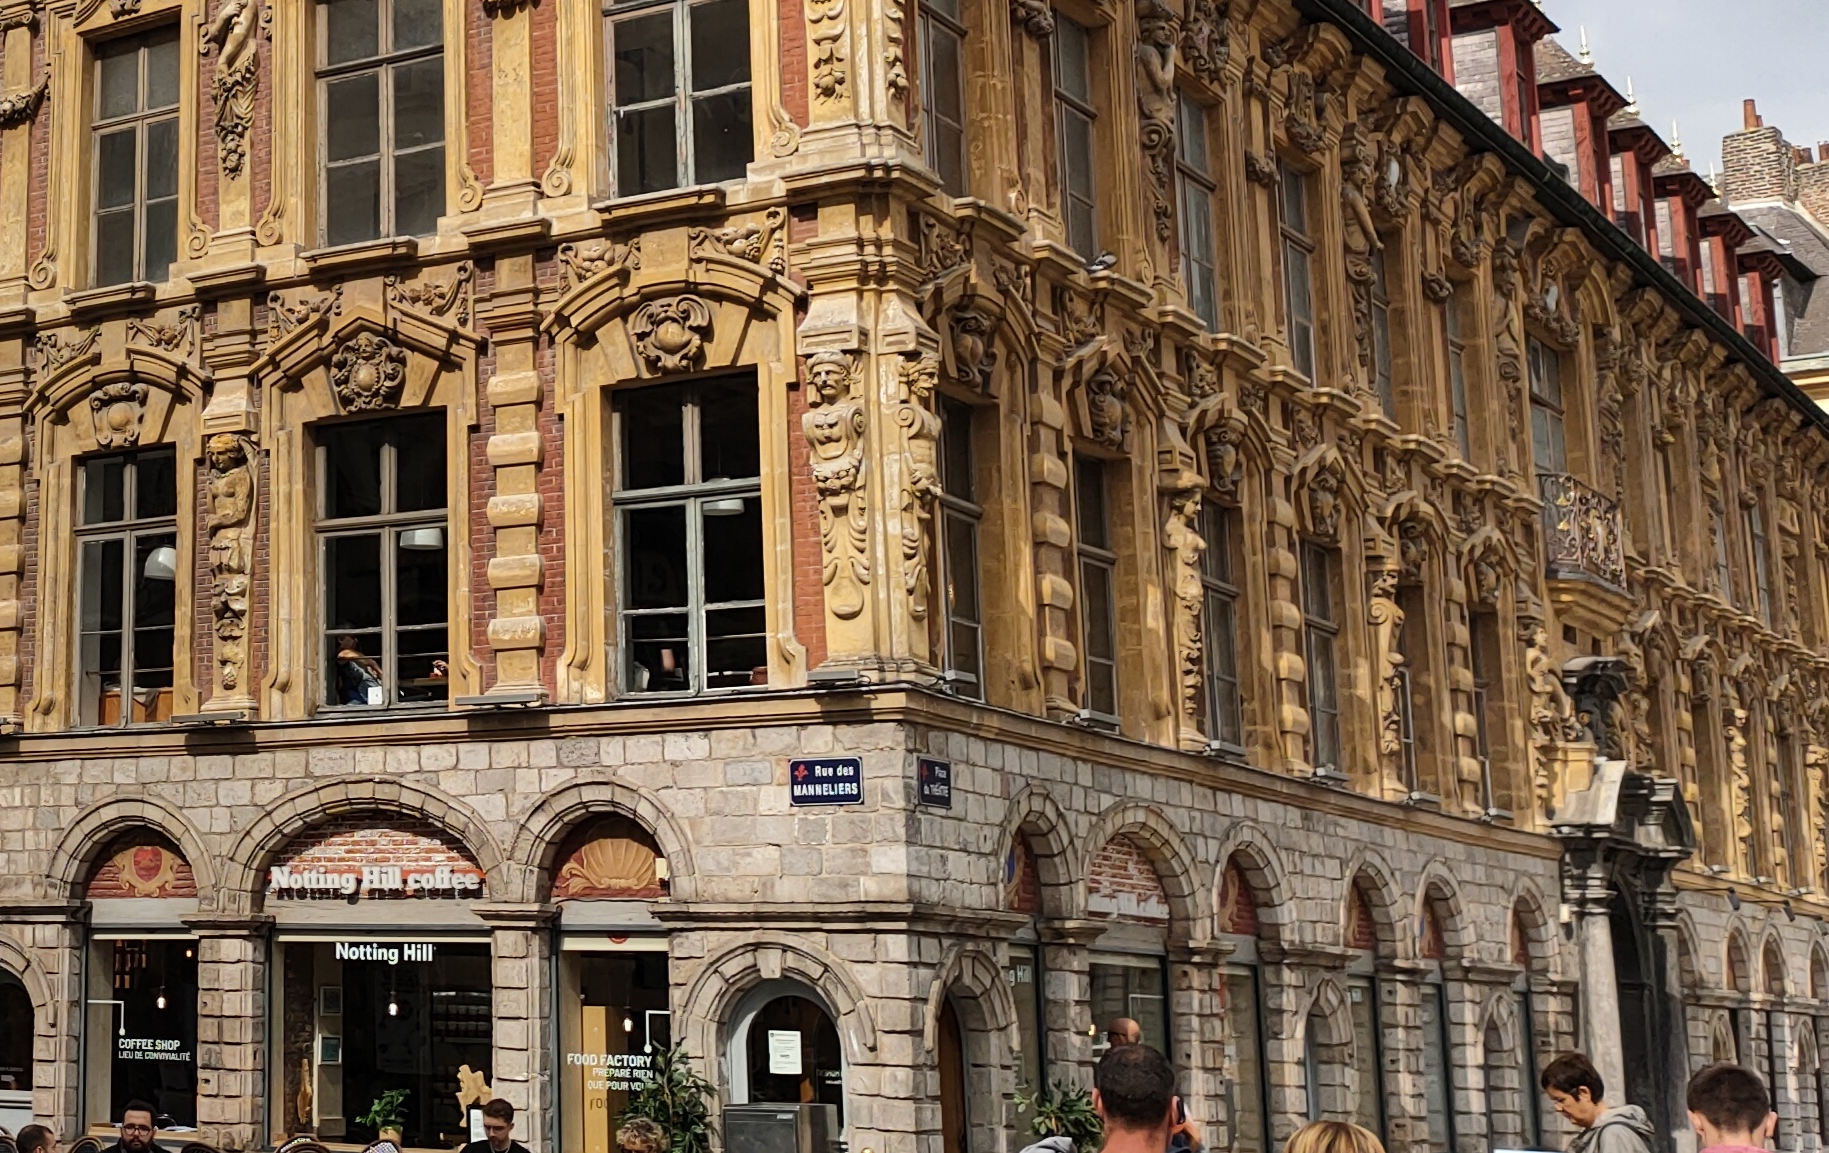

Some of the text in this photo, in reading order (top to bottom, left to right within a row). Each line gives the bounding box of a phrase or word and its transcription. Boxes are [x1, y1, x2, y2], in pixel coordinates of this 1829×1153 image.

[815, 764, 854, 777] Rue des
[793, 783, 858, 796] MANNELIERS
[270, 866, 480, 894] Notting Hill coffee
[335, 943, 433, 965] Notting Hill
[118, 1038, 181, 1051] COFFEE SHOP
[118, 1051, 134, 1059] LIEU
[134, 1051, 144, 1060] DE
[566, 1053, 653, 1068] FOOD FACTORY
[632, 1069, 654, 1079] RIEN
[587, 1080, 604, 1090] QUE
[605, 1080, 629, 1091] POUR
